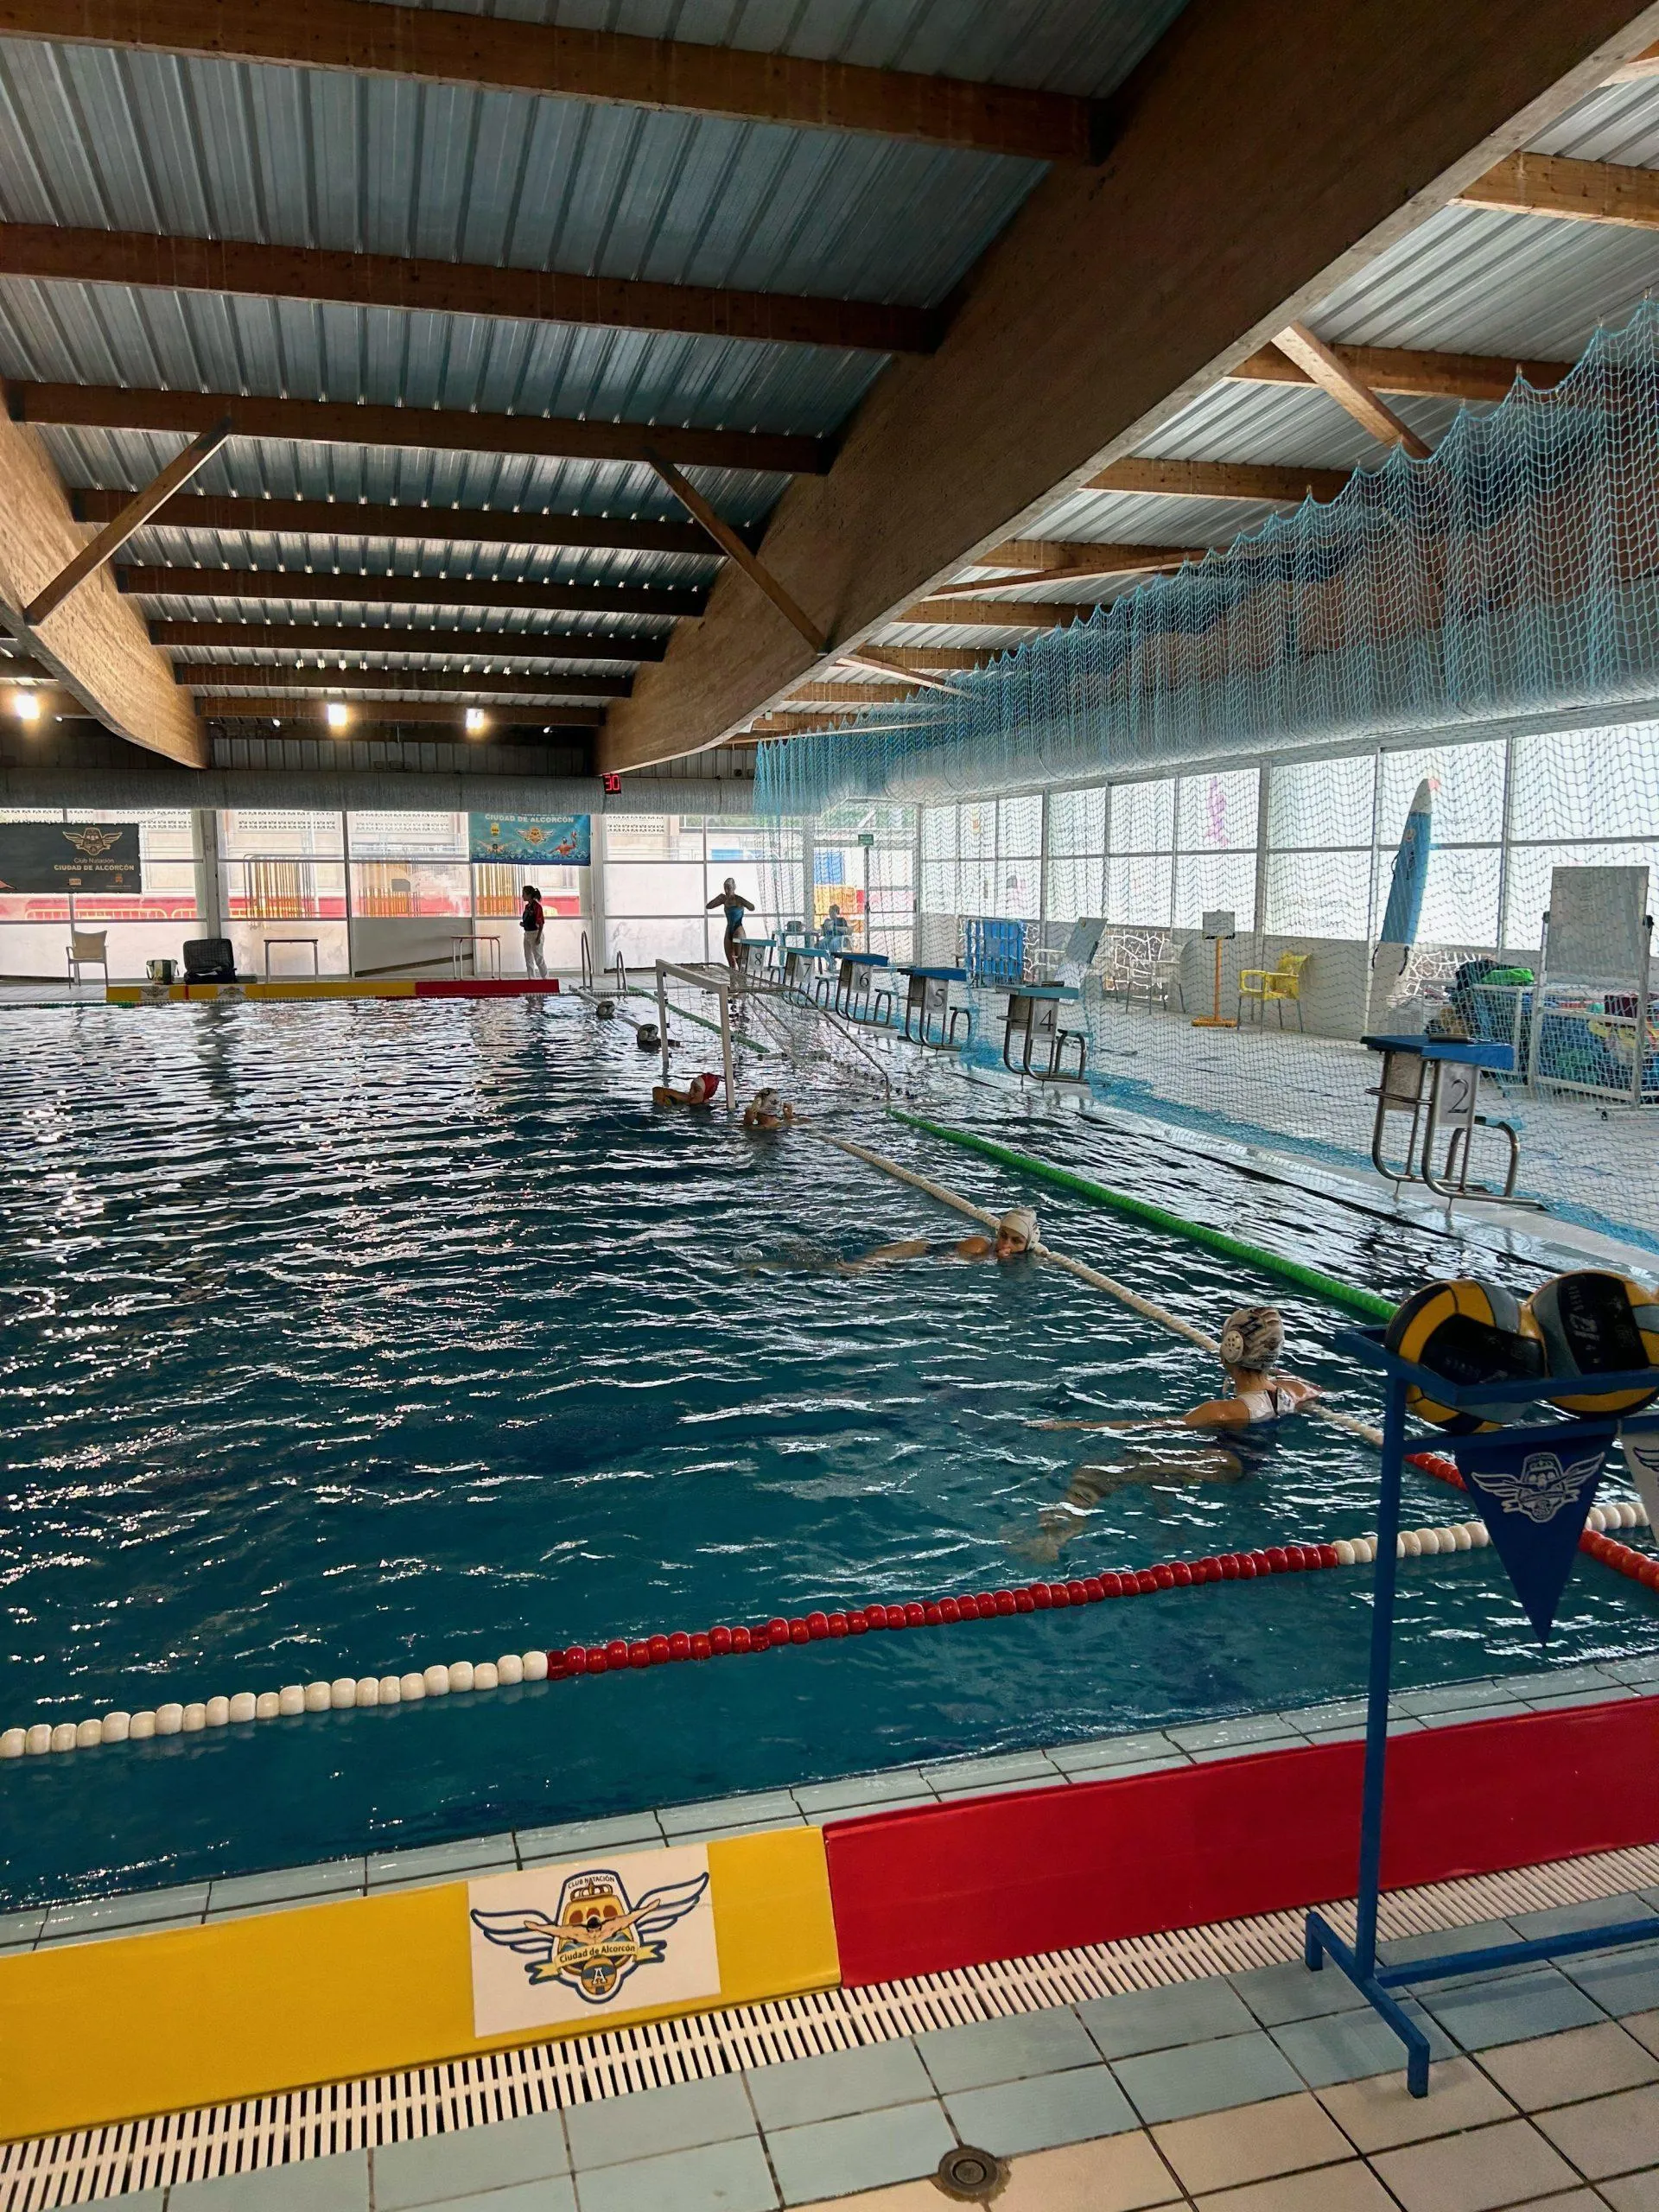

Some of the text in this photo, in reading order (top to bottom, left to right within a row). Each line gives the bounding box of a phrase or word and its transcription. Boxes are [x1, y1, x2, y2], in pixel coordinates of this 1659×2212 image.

[605, 775, 620, 791] 30
[753, 952, 763, 966] 8
[802, 963, 811, 976] 7
[859, 972, 869, 987] 6
[933, 988, 945, 1007] 5
[1039, 1010, 1054, 1032] 4
[1448, 1078, 1470, 1114] 2
[568, 1874, 615, 1890] CLUB NATACIÓN
[559, 1944, 636, 1963] Ciudad de Alcorcón
[593, 1967, 607, 1985] A
